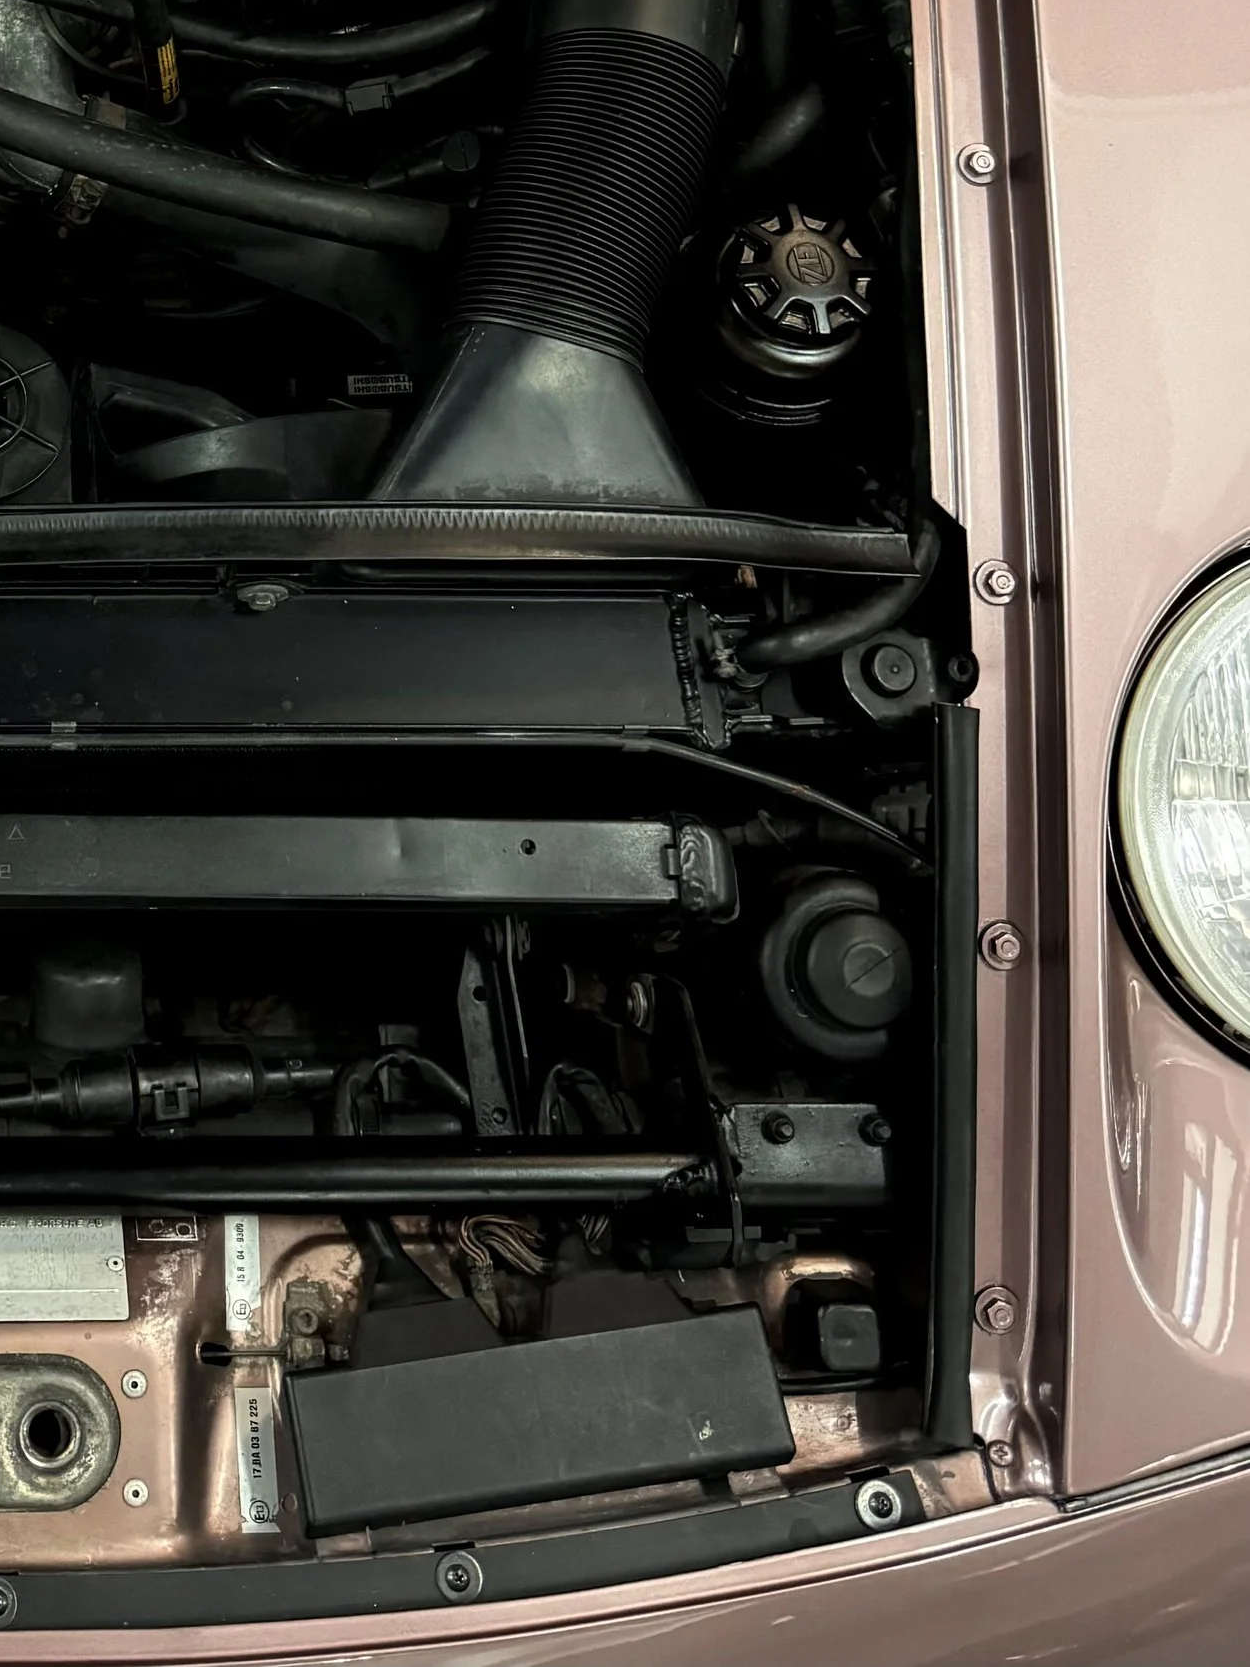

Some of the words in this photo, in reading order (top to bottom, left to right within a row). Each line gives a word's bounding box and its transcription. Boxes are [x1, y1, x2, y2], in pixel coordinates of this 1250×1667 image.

[236, 1223, 244, 1243] 9309
[236, 1250, 245, 1260] 04
[249, 1398, 258, 1418] 225
[251, 1436, 260, 1449] 03
